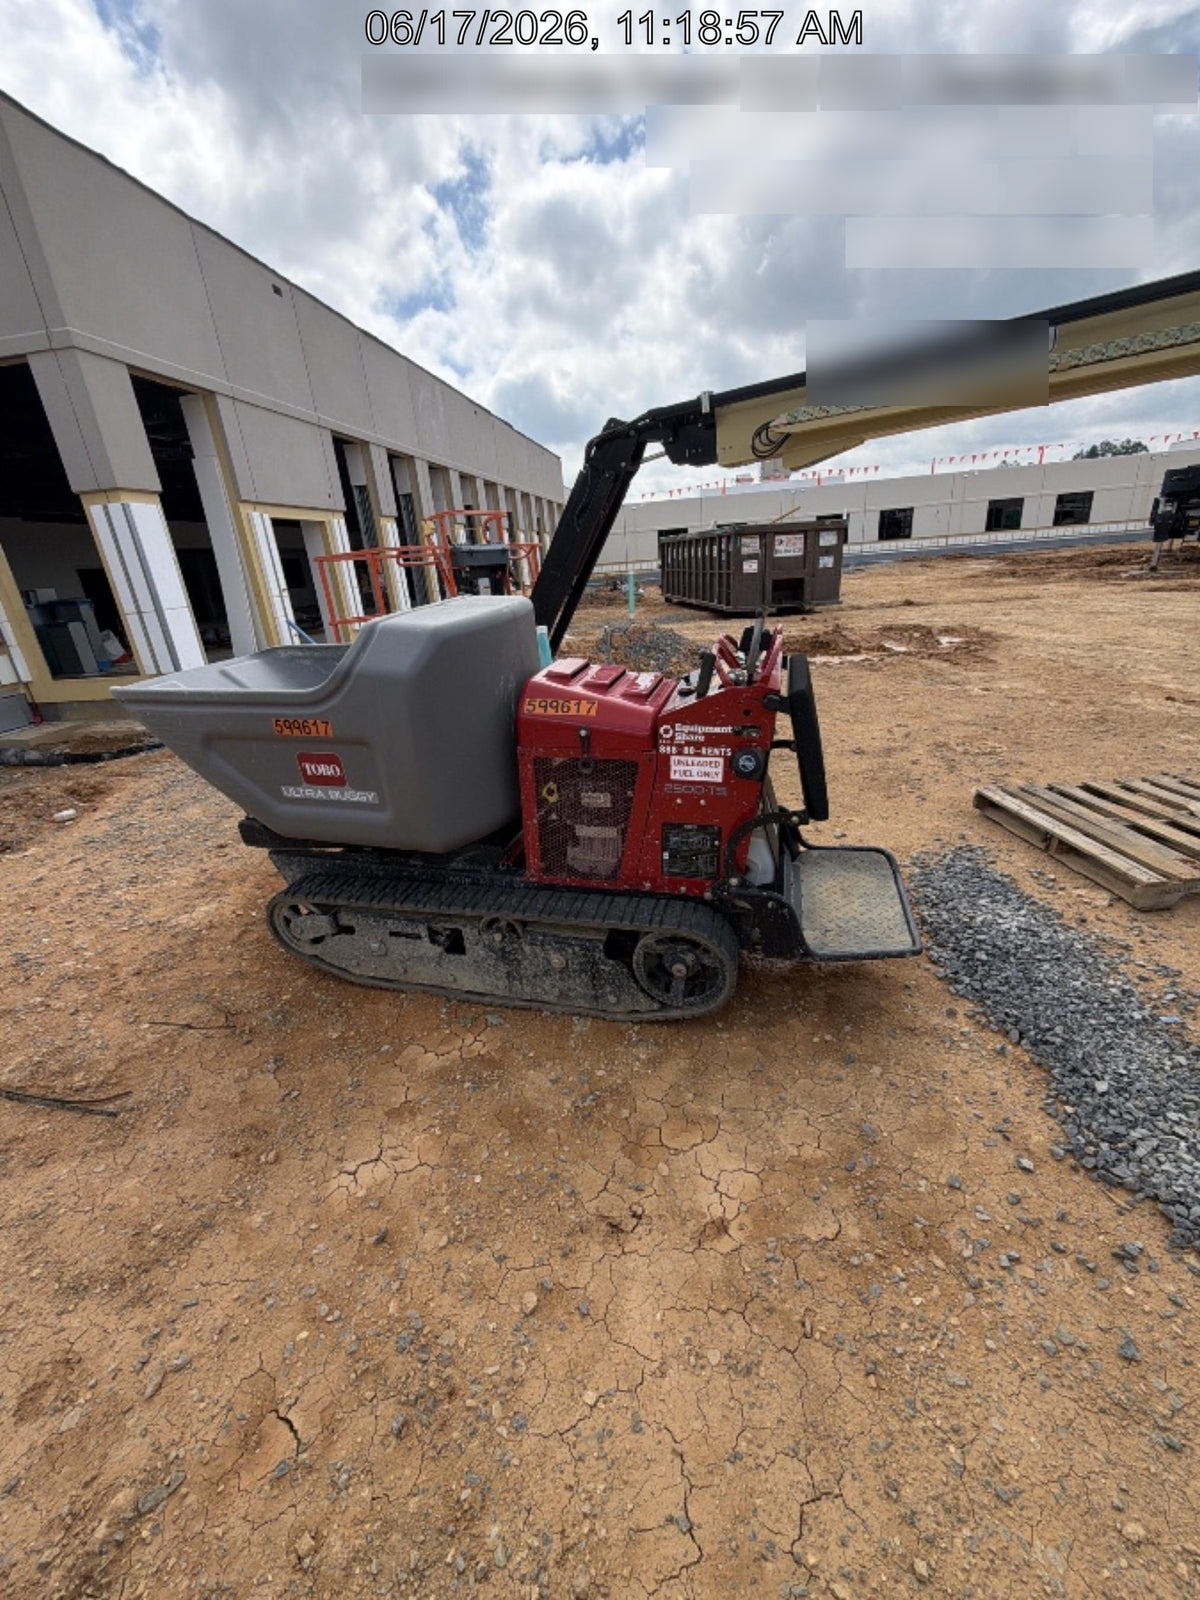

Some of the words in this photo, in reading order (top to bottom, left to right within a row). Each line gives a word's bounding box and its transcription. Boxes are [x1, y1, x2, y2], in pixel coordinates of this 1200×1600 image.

[526, 699, 596, 714] 599617
[274, 719, 330, 736] 599617
[675, 723, 733, 734] Equipment
[675, 732, 705, 742] Share
[302, 762, 341, 777] TORO
[673, 758, 721, 769] UNLEADED
[673, 768, 695, 778] FUEL
[696, 770, 721, 780] ONLY
[280, 785, 326, 799] ULTRA
[328, 788, 380, 804] BUGGY
